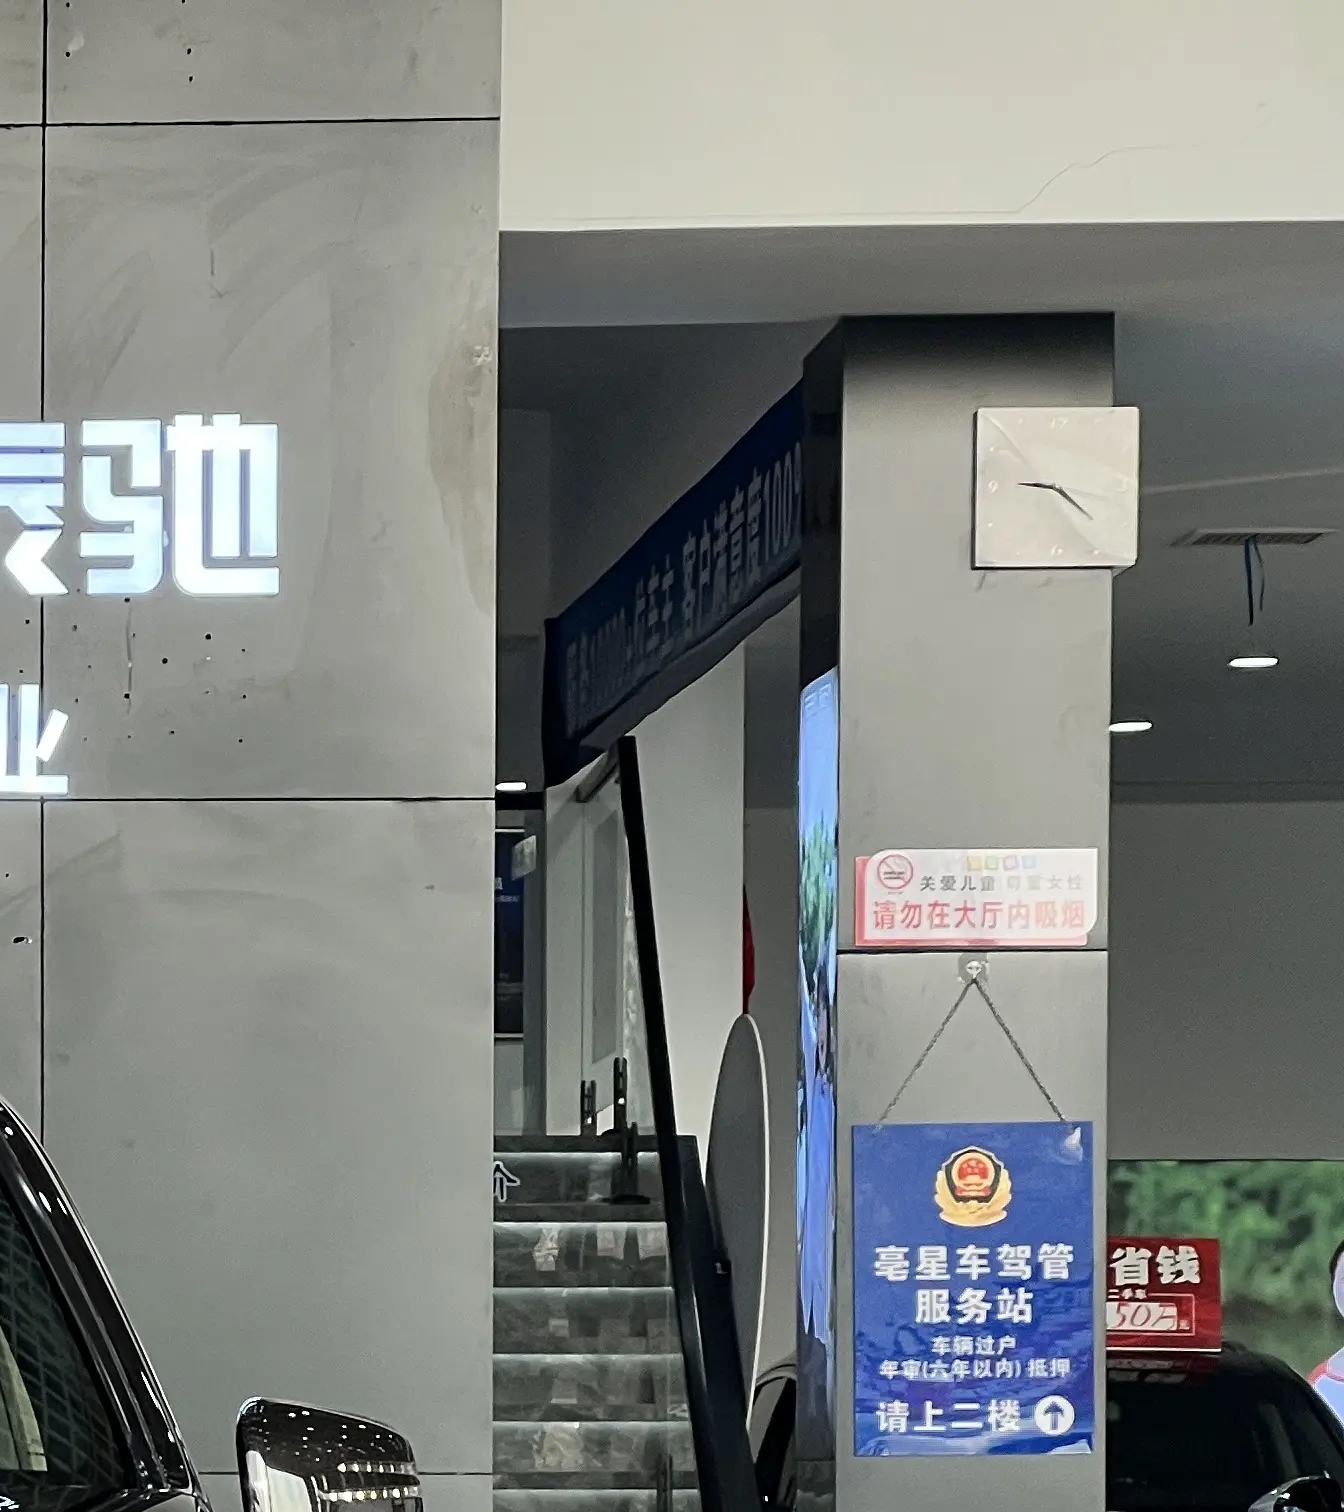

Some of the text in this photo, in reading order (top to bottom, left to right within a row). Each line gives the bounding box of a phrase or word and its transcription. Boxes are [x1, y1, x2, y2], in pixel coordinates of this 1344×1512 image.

[919, 875, 996, 892] 关爱儿童
[873, 900, 1085, 930] 请勿在大厅内吸烟
[1109, 1245, 1201, 1287] 省钱
[915, 1287, 1035, 1325] 服务站
[931, 1335, 1017, 1356] 车辆过户
[1027, 1357, 1072, 1378] 抵押
[875, 1399, 1022, 1434] 请上二楼
